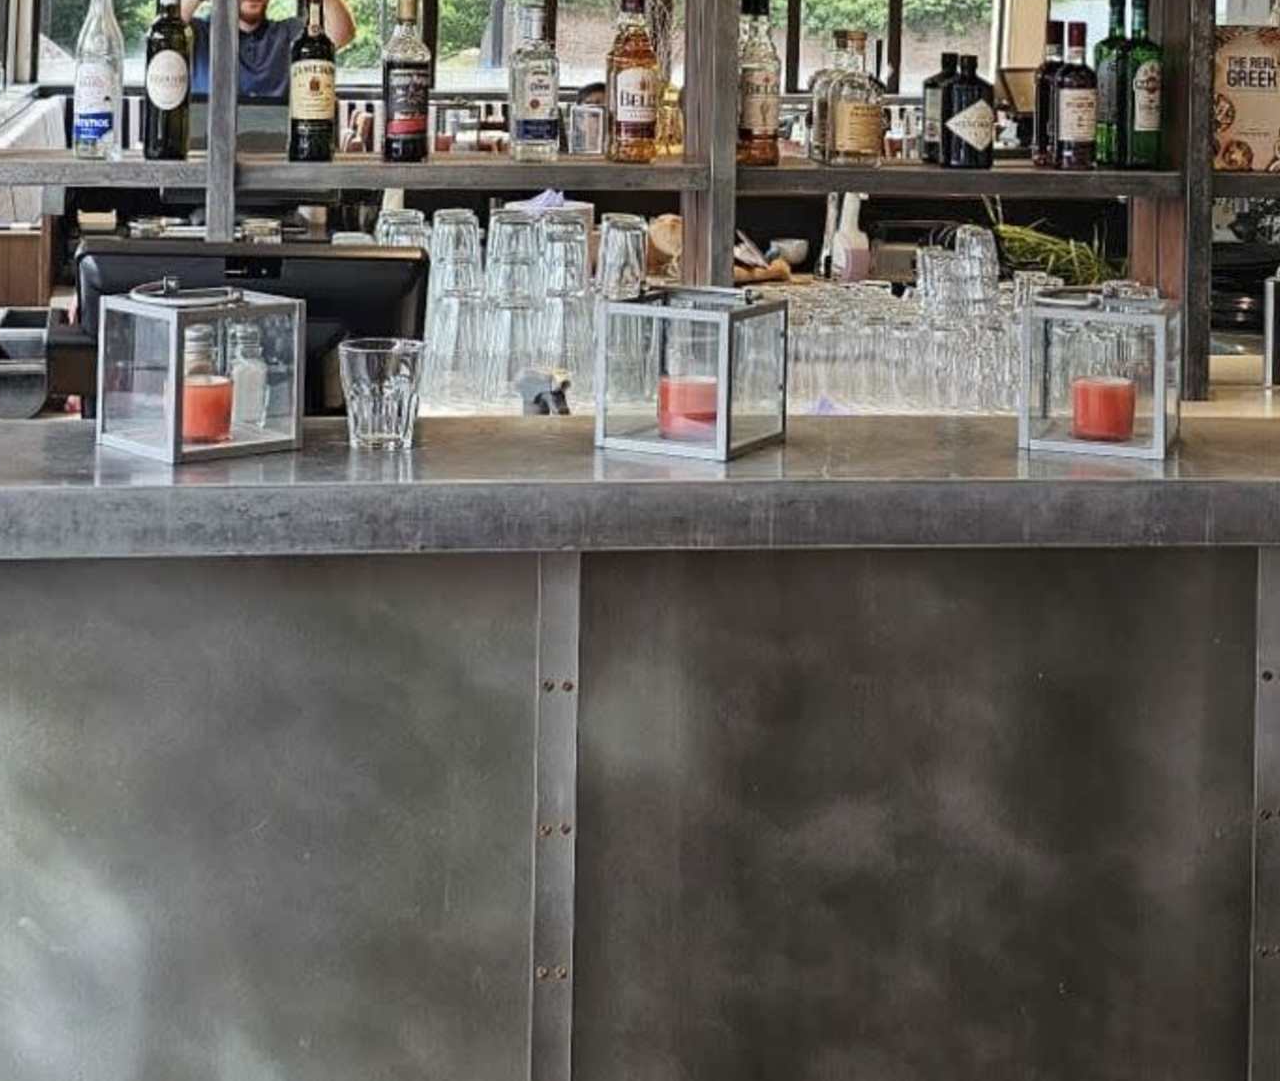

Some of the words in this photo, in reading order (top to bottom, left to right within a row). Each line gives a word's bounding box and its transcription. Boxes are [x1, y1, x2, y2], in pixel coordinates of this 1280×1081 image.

[1228, 57, 1247, 69] THE
[1249, 57, 1276, 70] REAL
[1227, 71, 1277, 88] GREEK
